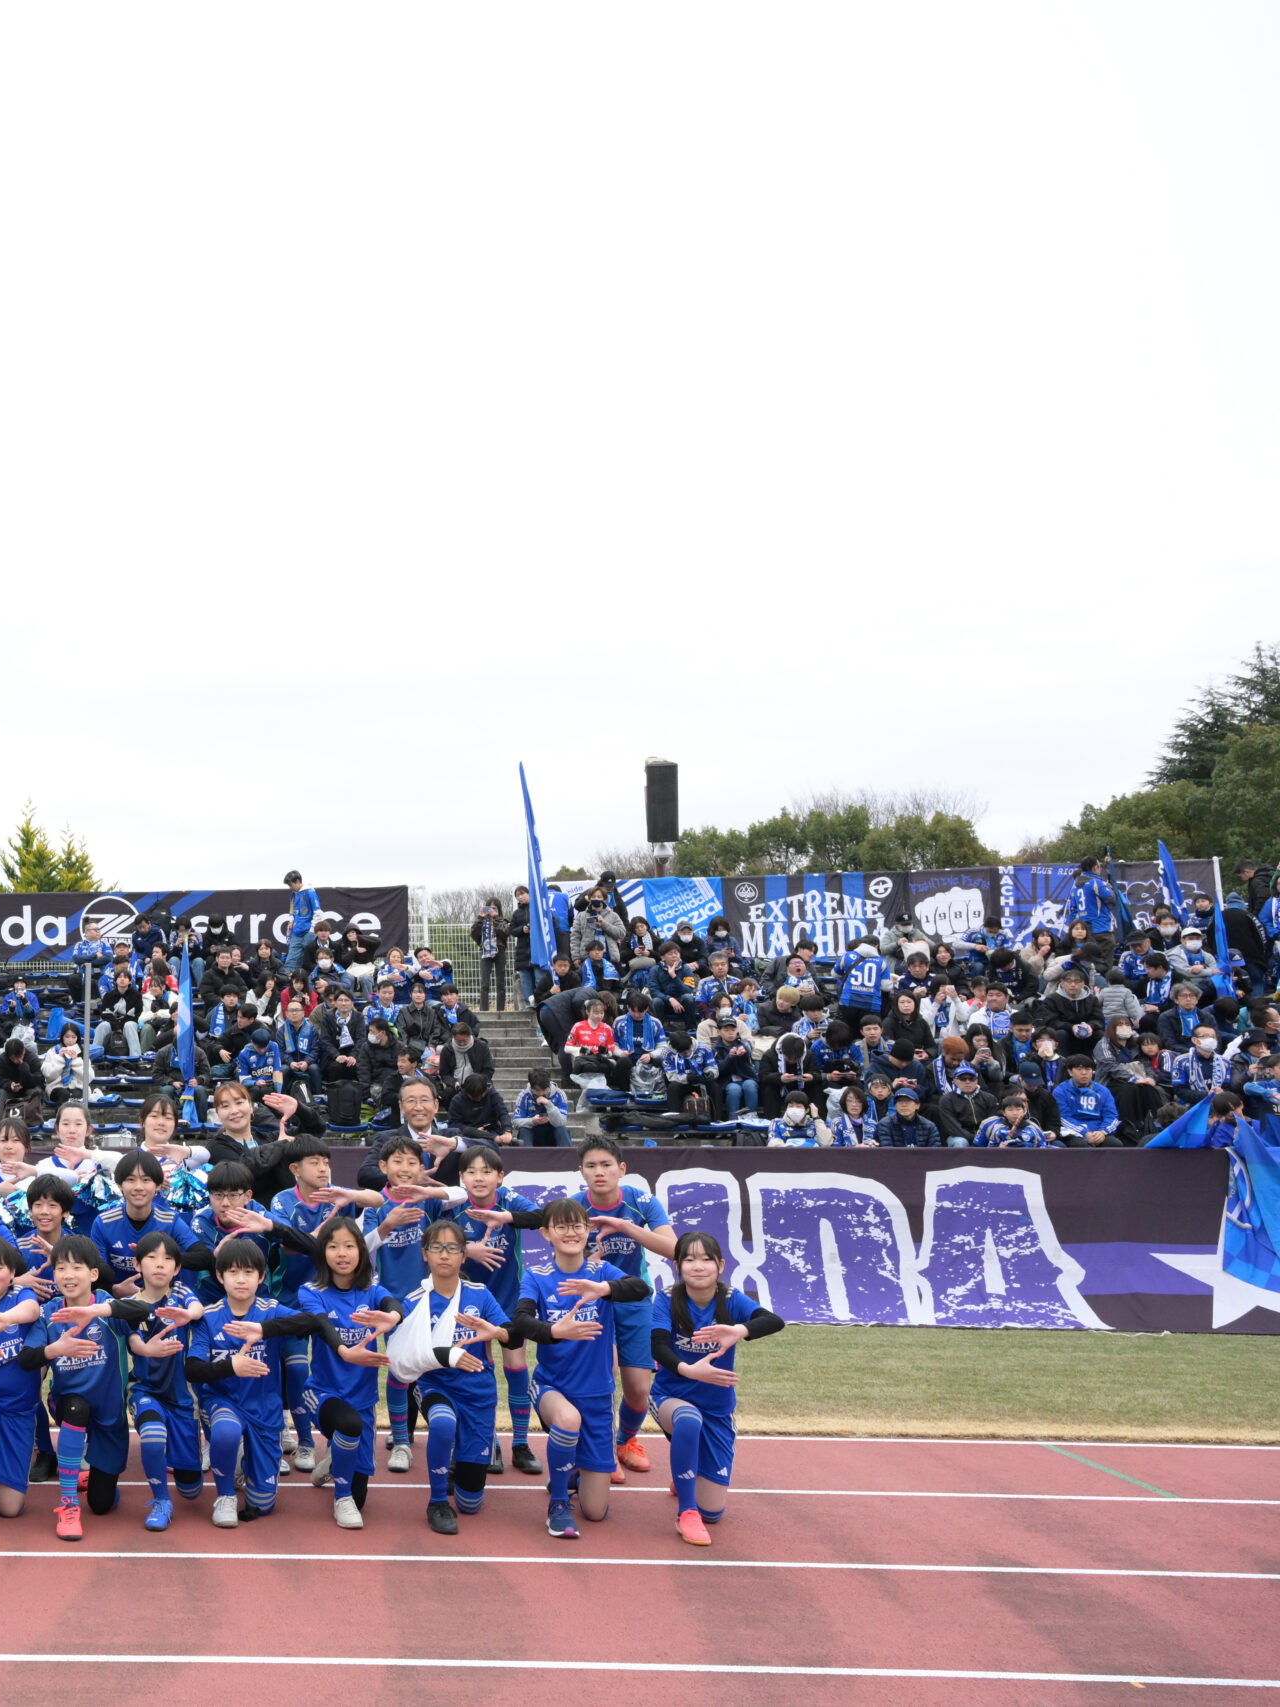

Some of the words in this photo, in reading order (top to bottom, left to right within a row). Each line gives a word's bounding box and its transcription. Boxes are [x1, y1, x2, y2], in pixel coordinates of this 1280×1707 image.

[1031, 866, 1053, 874] BLUE
[650, 887, 702, 913] machida
[655, 895, 707, 923] machida
[748, 889, 883, 923] EXTREME
[740, 917, 890, 959] MACHIDA
[850, 962, 877, 987] 50
[1079, 1096, 1096, 1110] 49
